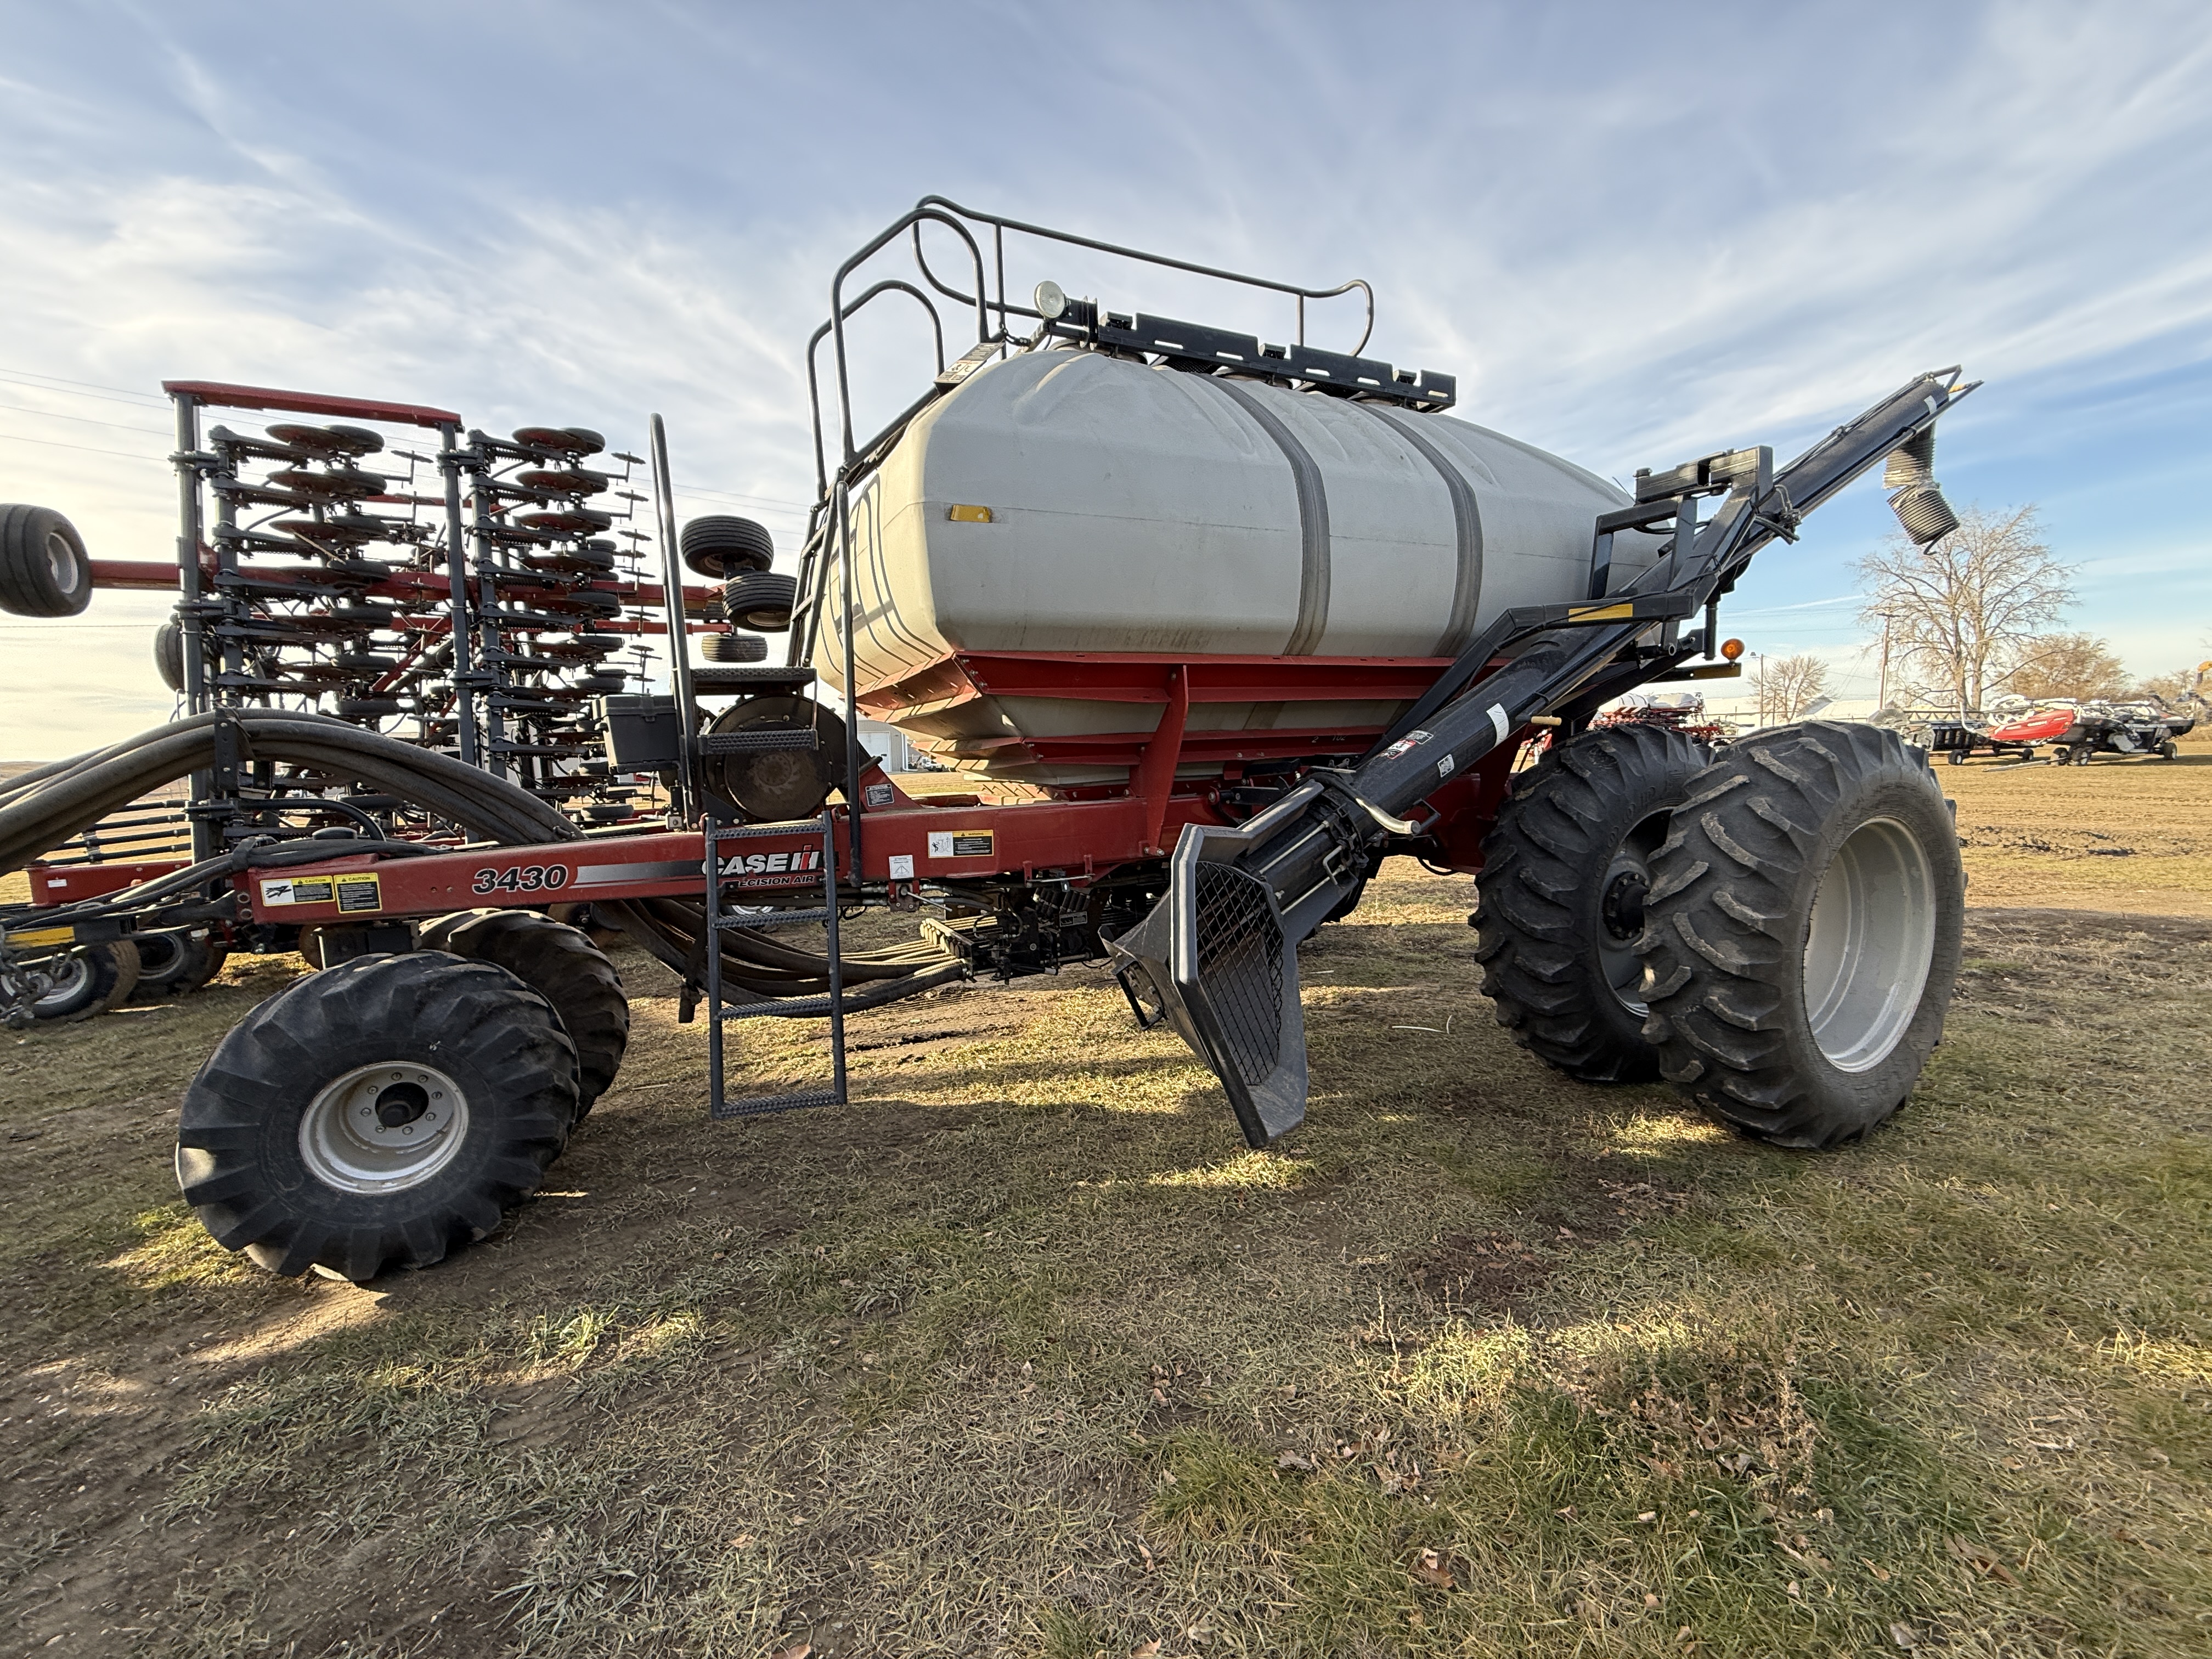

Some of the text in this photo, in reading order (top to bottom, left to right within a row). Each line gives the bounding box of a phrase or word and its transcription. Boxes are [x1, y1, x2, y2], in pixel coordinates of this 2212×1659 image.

[472, 864, 568, 895] 3430
[734, 875, 815, 888] ECISION AIR
